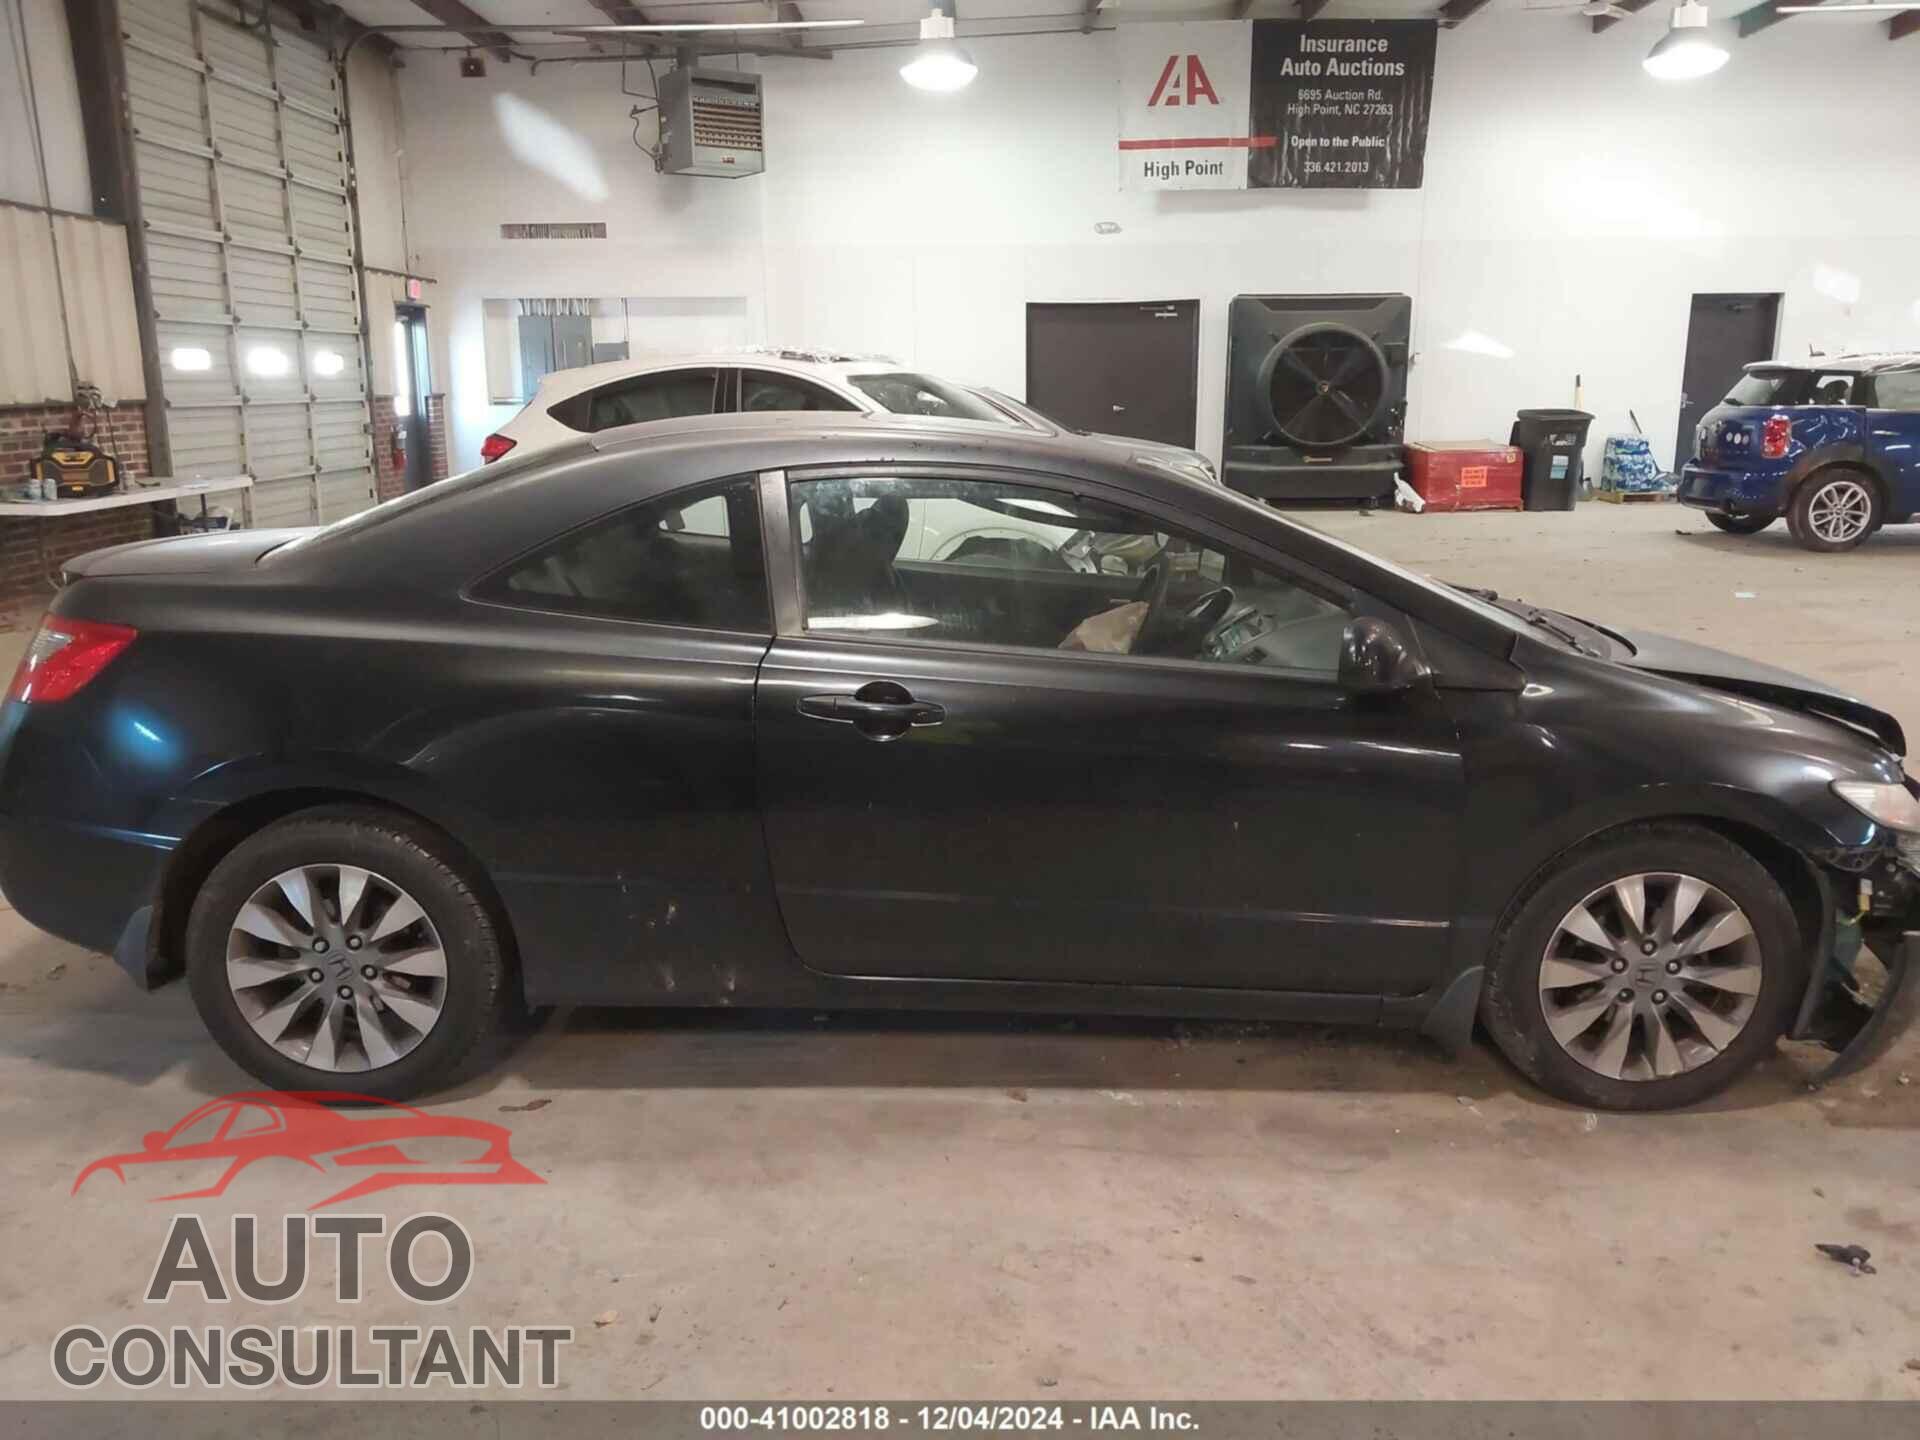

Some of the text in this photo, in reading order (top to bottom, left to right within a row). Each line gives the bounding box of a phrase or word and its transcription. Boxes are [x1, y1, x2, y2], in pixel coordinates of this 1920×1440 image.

[1300, 34, 1388, 52] Insurance
[1280, 57, 1405, 76] Auto Auctions
[1325, 89, 1364, 100] Auction
[1367, 89, 1384, 100] Rd.
[1287, 103, 1393, 118] High Point, NC 27263
[1291, 135, 1385, 149] Open to the Public
[1144, 160, 1223, 180] High Point
